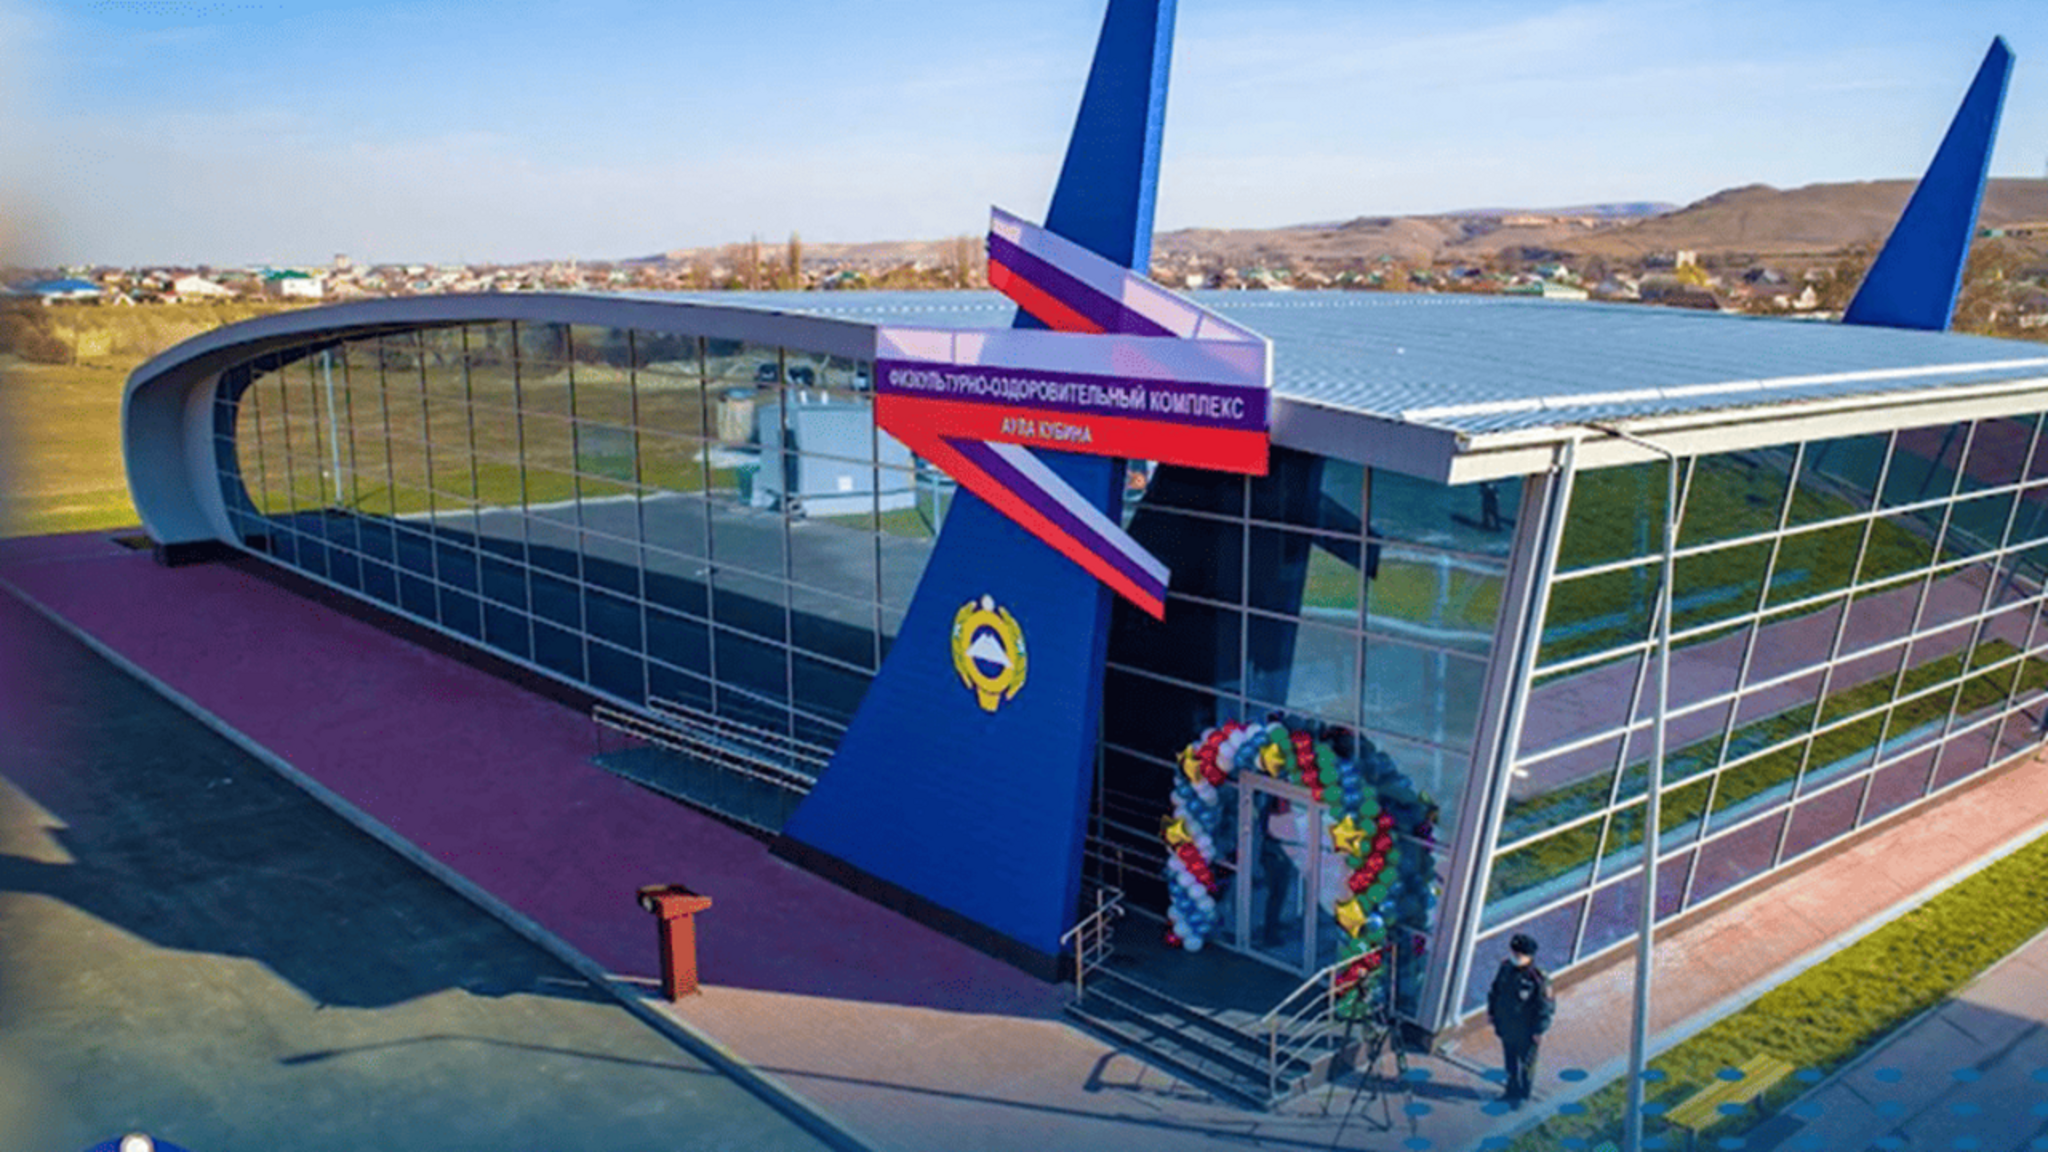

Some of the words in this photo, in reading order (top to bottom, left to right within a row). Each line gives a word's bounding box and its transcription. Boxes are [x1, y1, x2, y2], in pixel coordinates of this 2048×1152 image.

[888, 369, 1146, 410] ФИЗКУЛЬТУРНО-ОЗДОРОВИТЕЛЬНЫЙ
[1149, 391, 1245, 420] КОМПЛЕКС
[1001, 417, 1035, 436] АУЛА
[1039, 422, 1092, 443] КУБИНА
